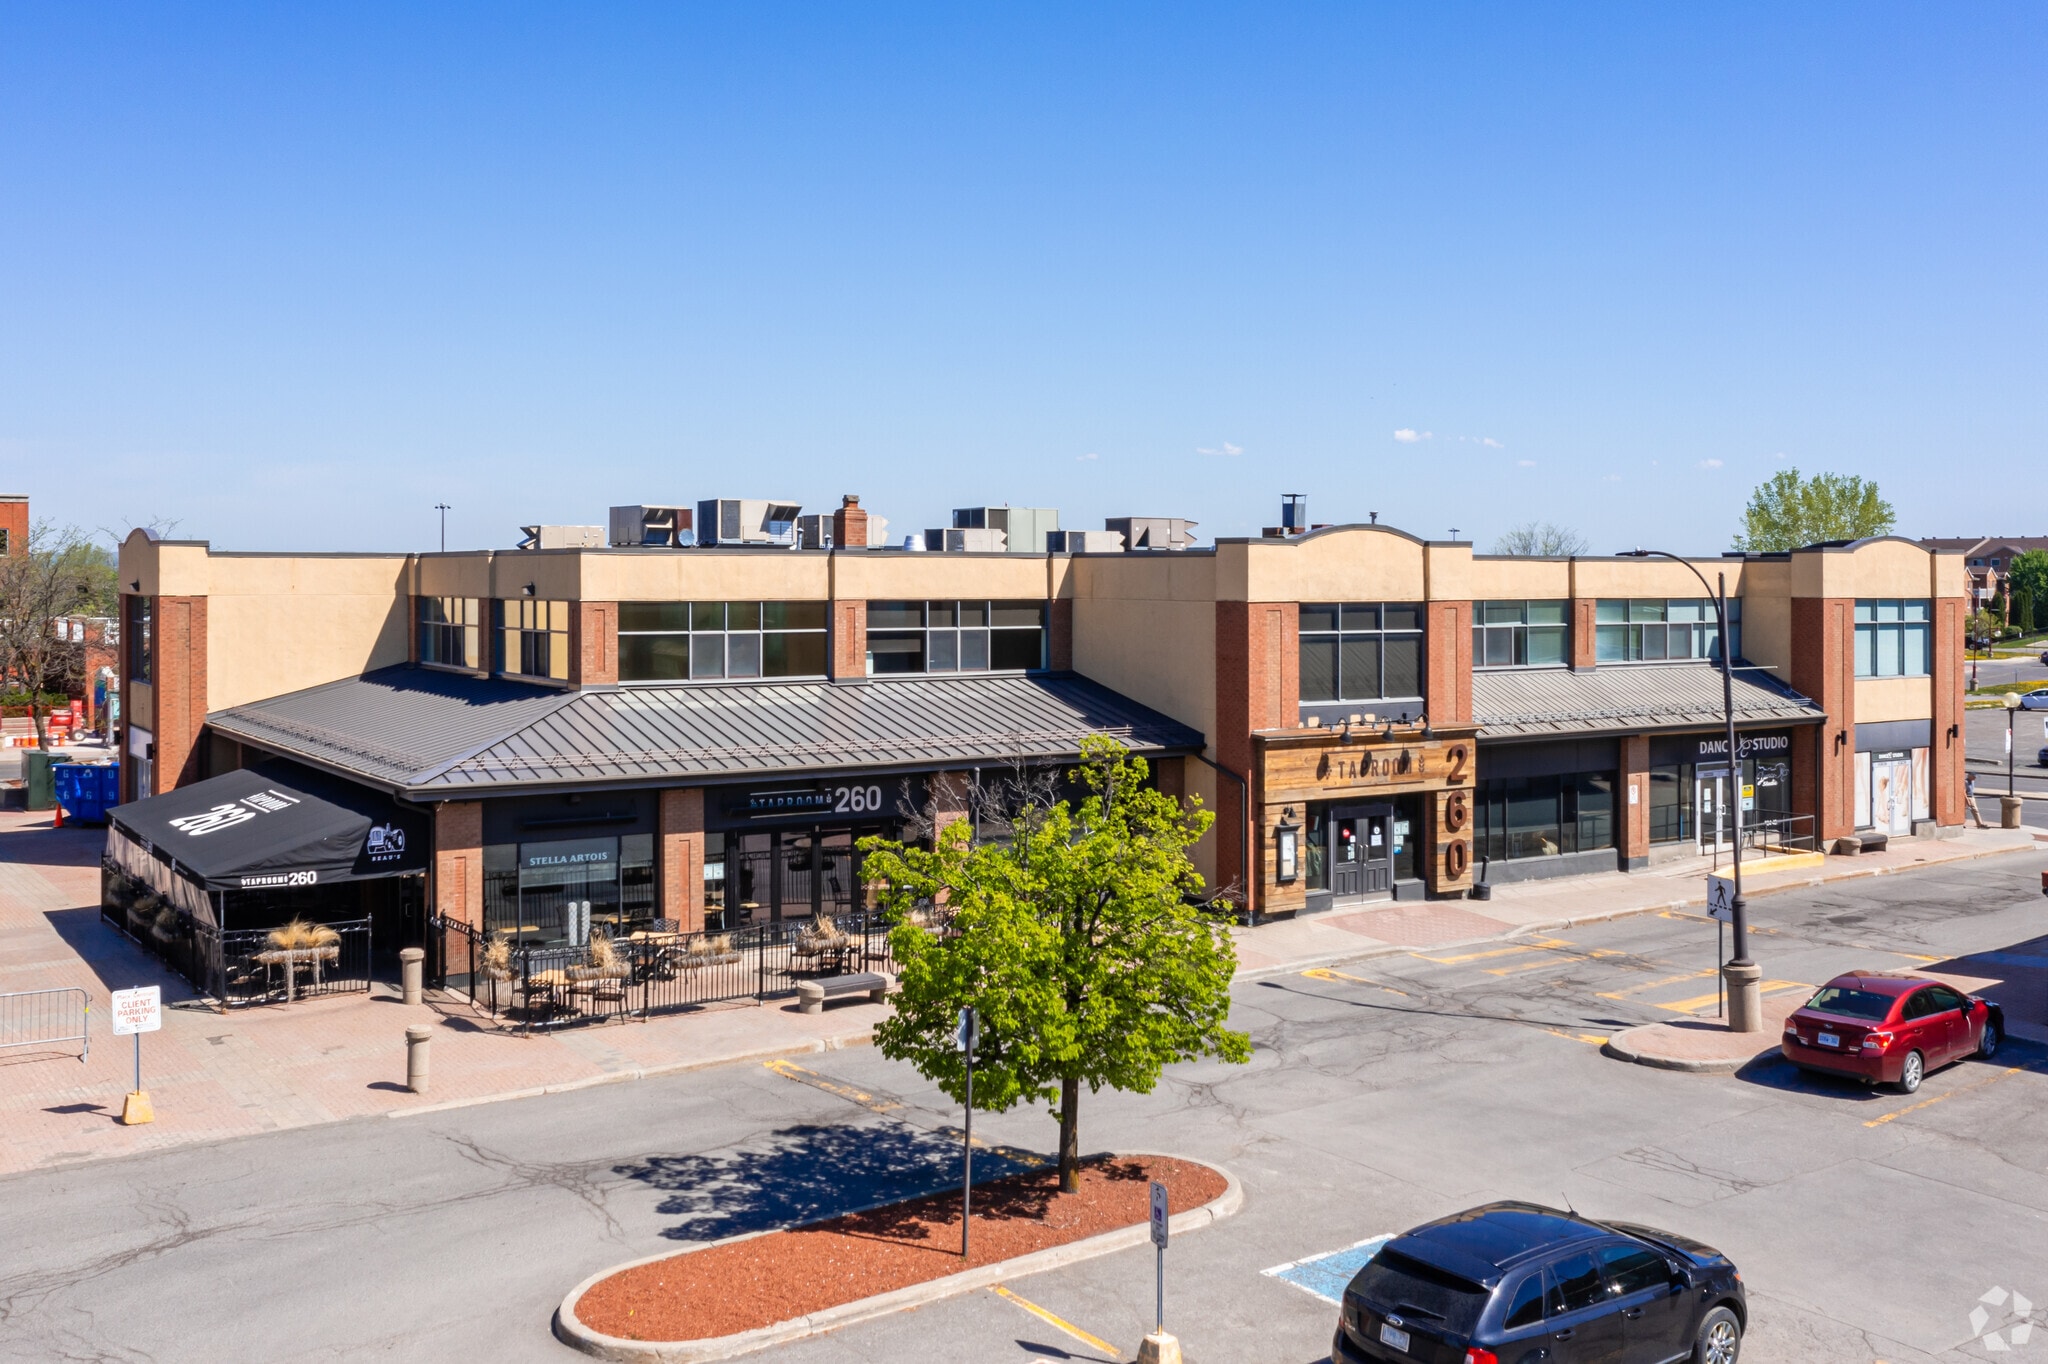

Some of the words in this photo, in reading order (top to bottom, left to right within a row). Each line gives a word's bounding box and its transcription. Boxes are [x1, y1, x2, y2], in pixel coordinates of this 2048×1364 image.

[1753, 736, 1788, 750] STUDIO
[835, 785, 881, 812] 260
[168, 803, 257, 836] 260
[529, 855, 567, 866] STELLA
[569, 851, 608, 863] ARTOIS
[246, 875, 284, 886] TAPROOM
[288, 870, 317, 886] 260
[122, 999, 151, 1008] CLIENT
[118, 1006, 156, 1016] PARKING
[126, 1015, 148, 1024] ONLY
